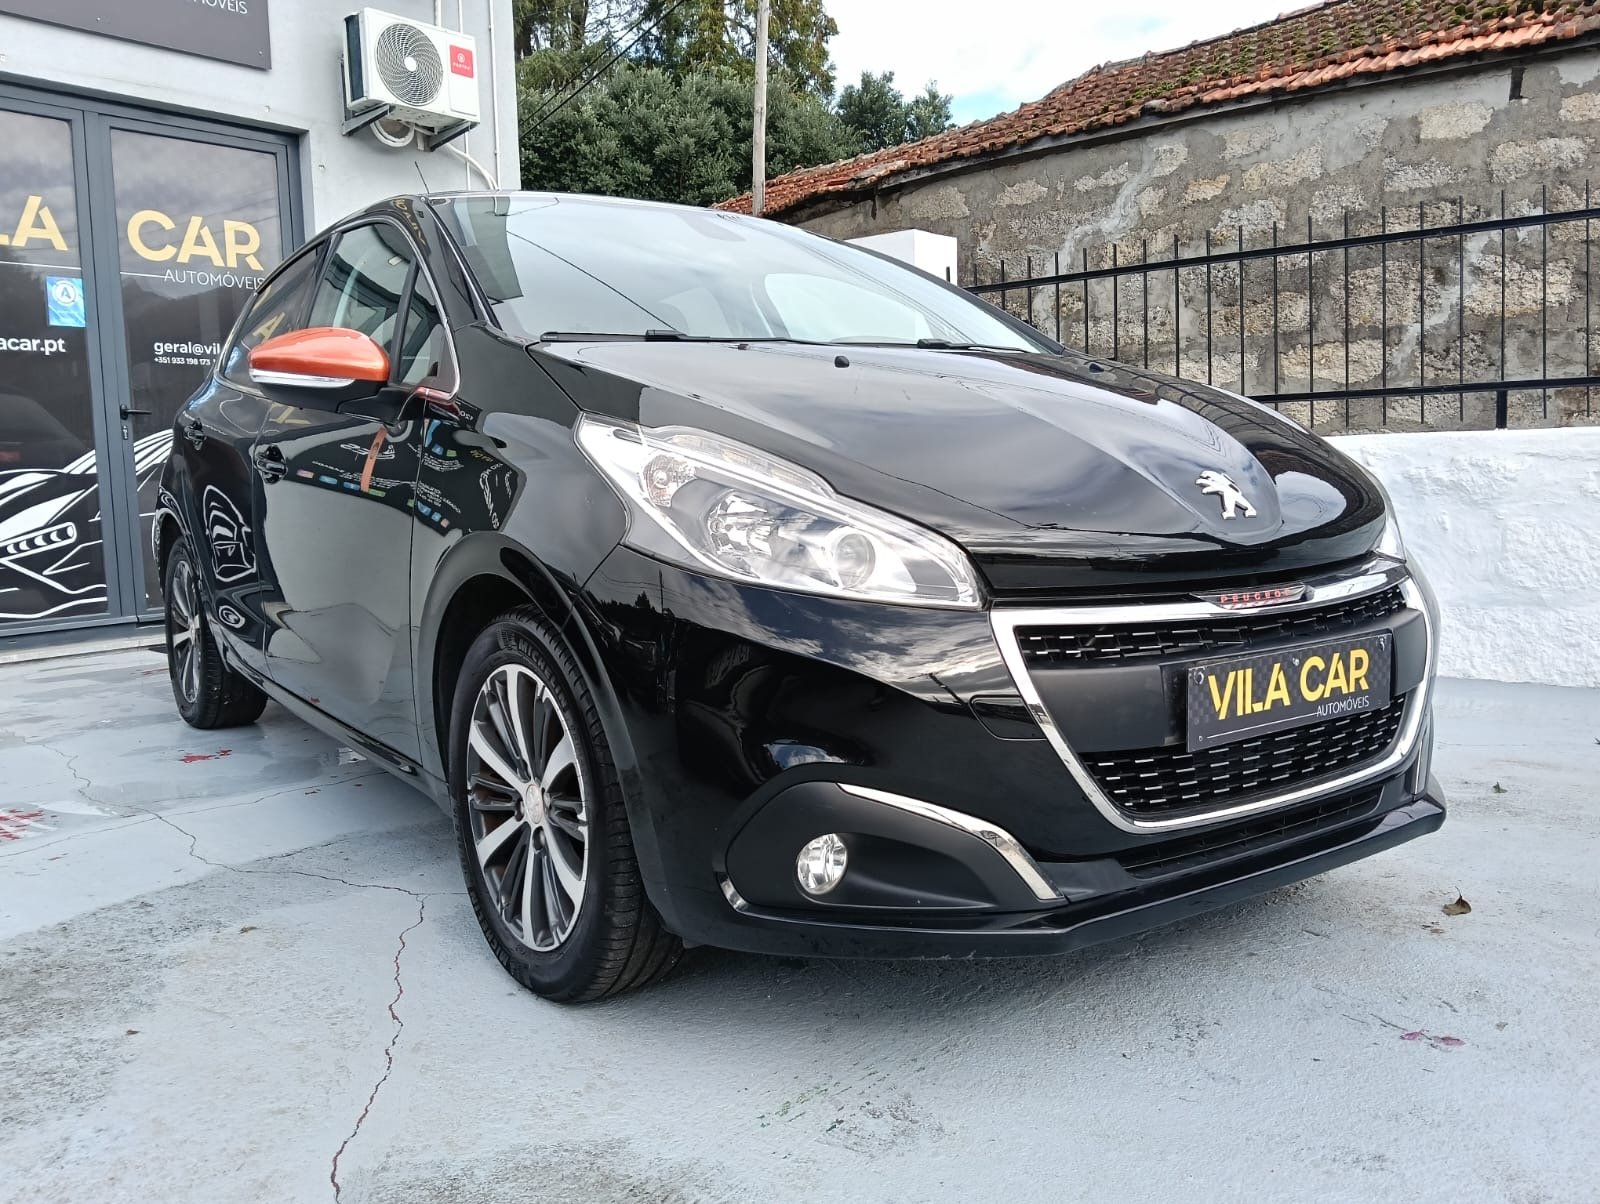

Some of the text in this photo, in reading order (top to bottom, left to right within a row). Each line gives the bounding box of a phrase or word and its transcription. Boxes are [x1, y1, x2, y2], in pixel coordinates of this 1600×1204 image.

[127, 210, 264, 271] CAR
[154, 356, 170, 364] +351
[517, 638, 570, 713] MICHELIN
[1208, 649, 1369, 720] VILA CAR
[1316, 695, 1370, 718] AUTOMÓVEIS
